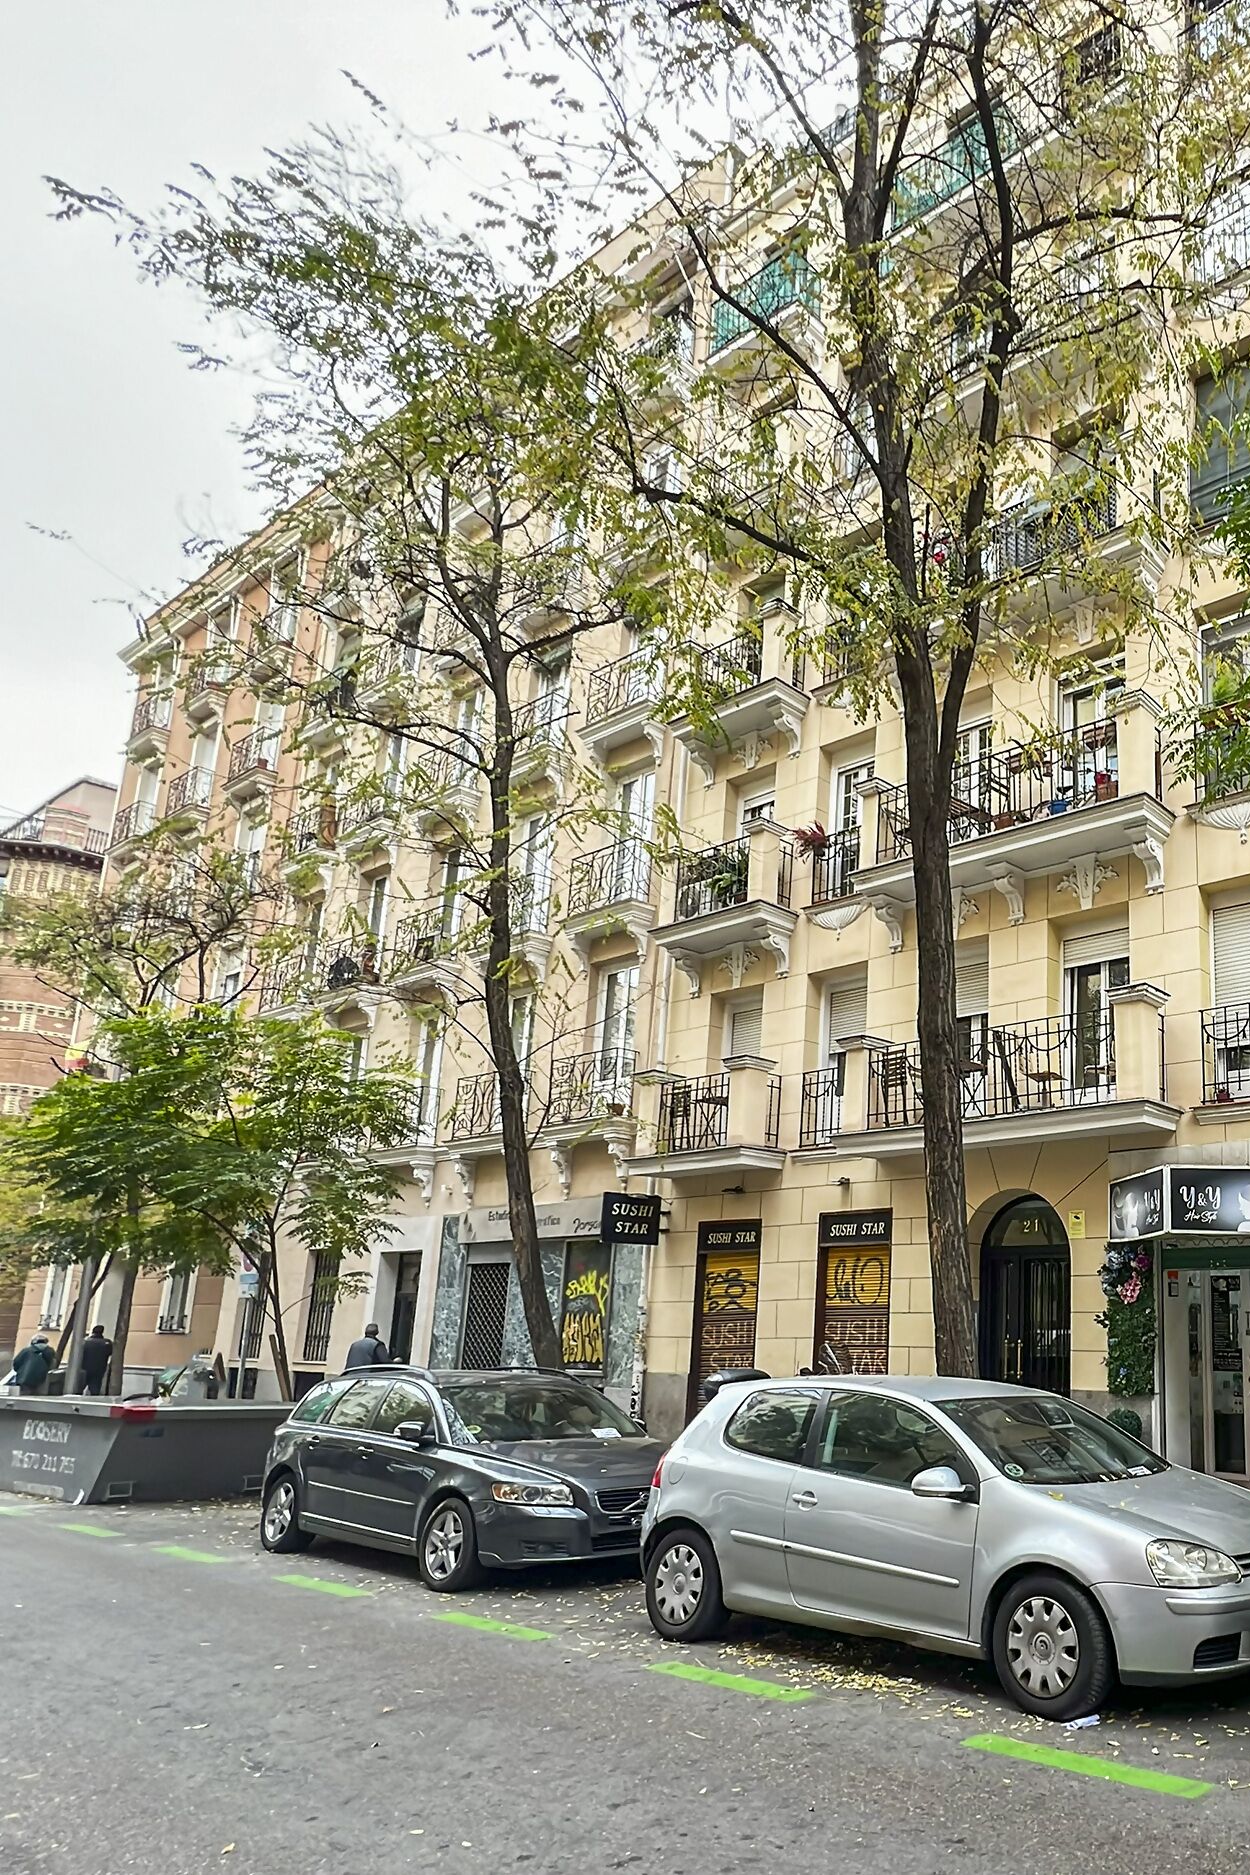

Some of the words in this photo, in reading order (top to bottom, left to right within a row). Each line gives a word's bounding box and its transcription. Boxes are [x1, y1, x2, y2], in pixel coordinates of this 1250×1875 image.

[1179, 1185, 1221, 1210] Y&Y
[611, 1203, 654, 1218] SUSHI
[614, 1221, 649, 1235] STAR
[829, 1223, 857, 1237] SUSHI
[861, 1221, 885, 1235] STAR
[1023, 1218, 1039, 1233] 21
[707, 1232, 732, 1244] SUSHI
[735, 1231, 756, 1243] STAR
